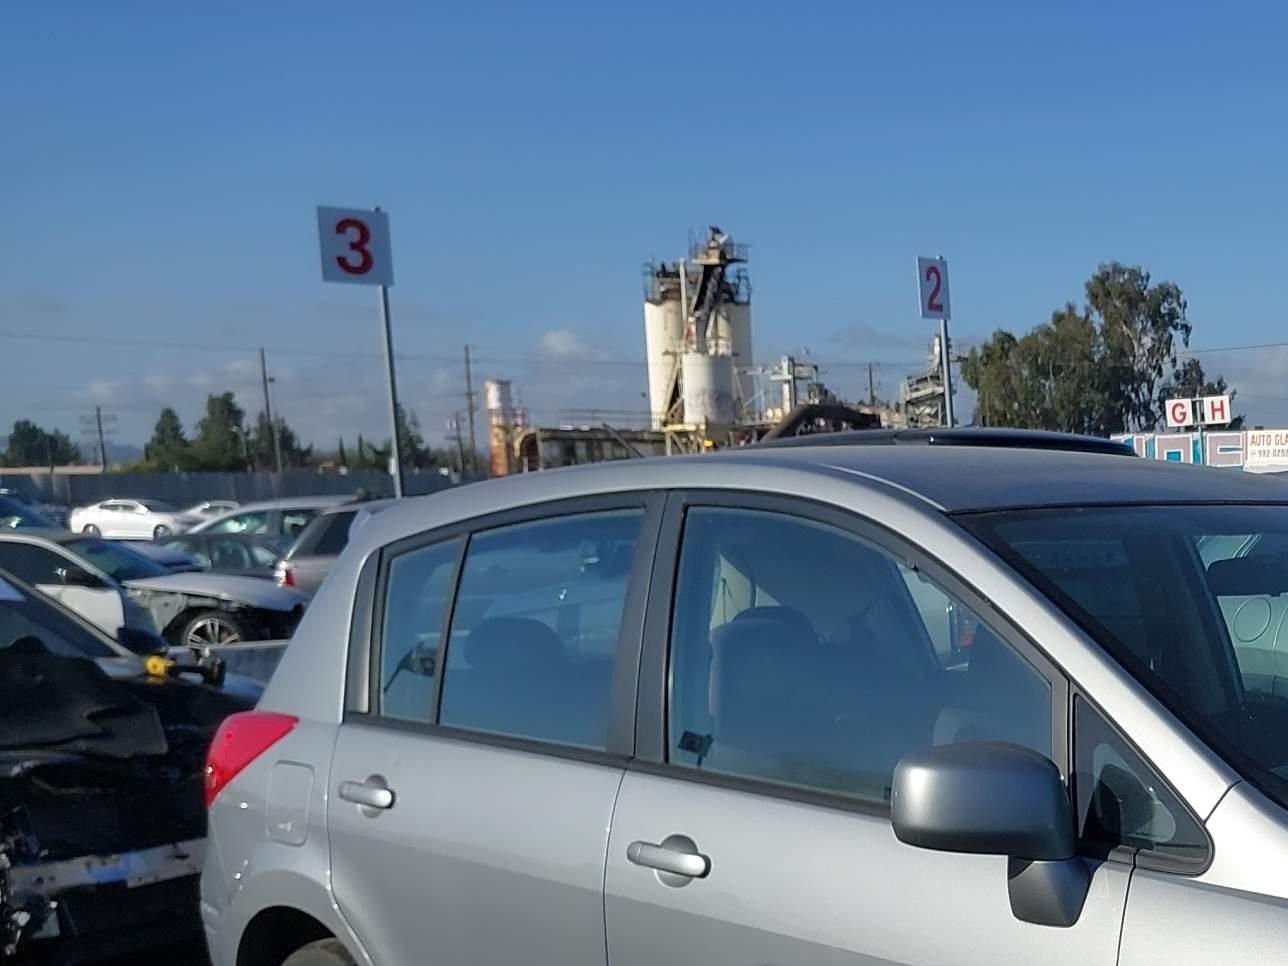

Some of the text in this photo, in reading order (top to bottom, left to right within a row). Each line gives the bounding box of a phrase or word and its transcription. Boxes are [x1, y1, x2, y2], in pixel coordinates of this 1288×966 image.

[335, 218, 374, 275] 3
[926, 266, 943, 312] 2
[1171, 402, 1187, 424] G
[1211, 399, 1225, 421] H
[1250, 434, 1272, 446] AUTO
